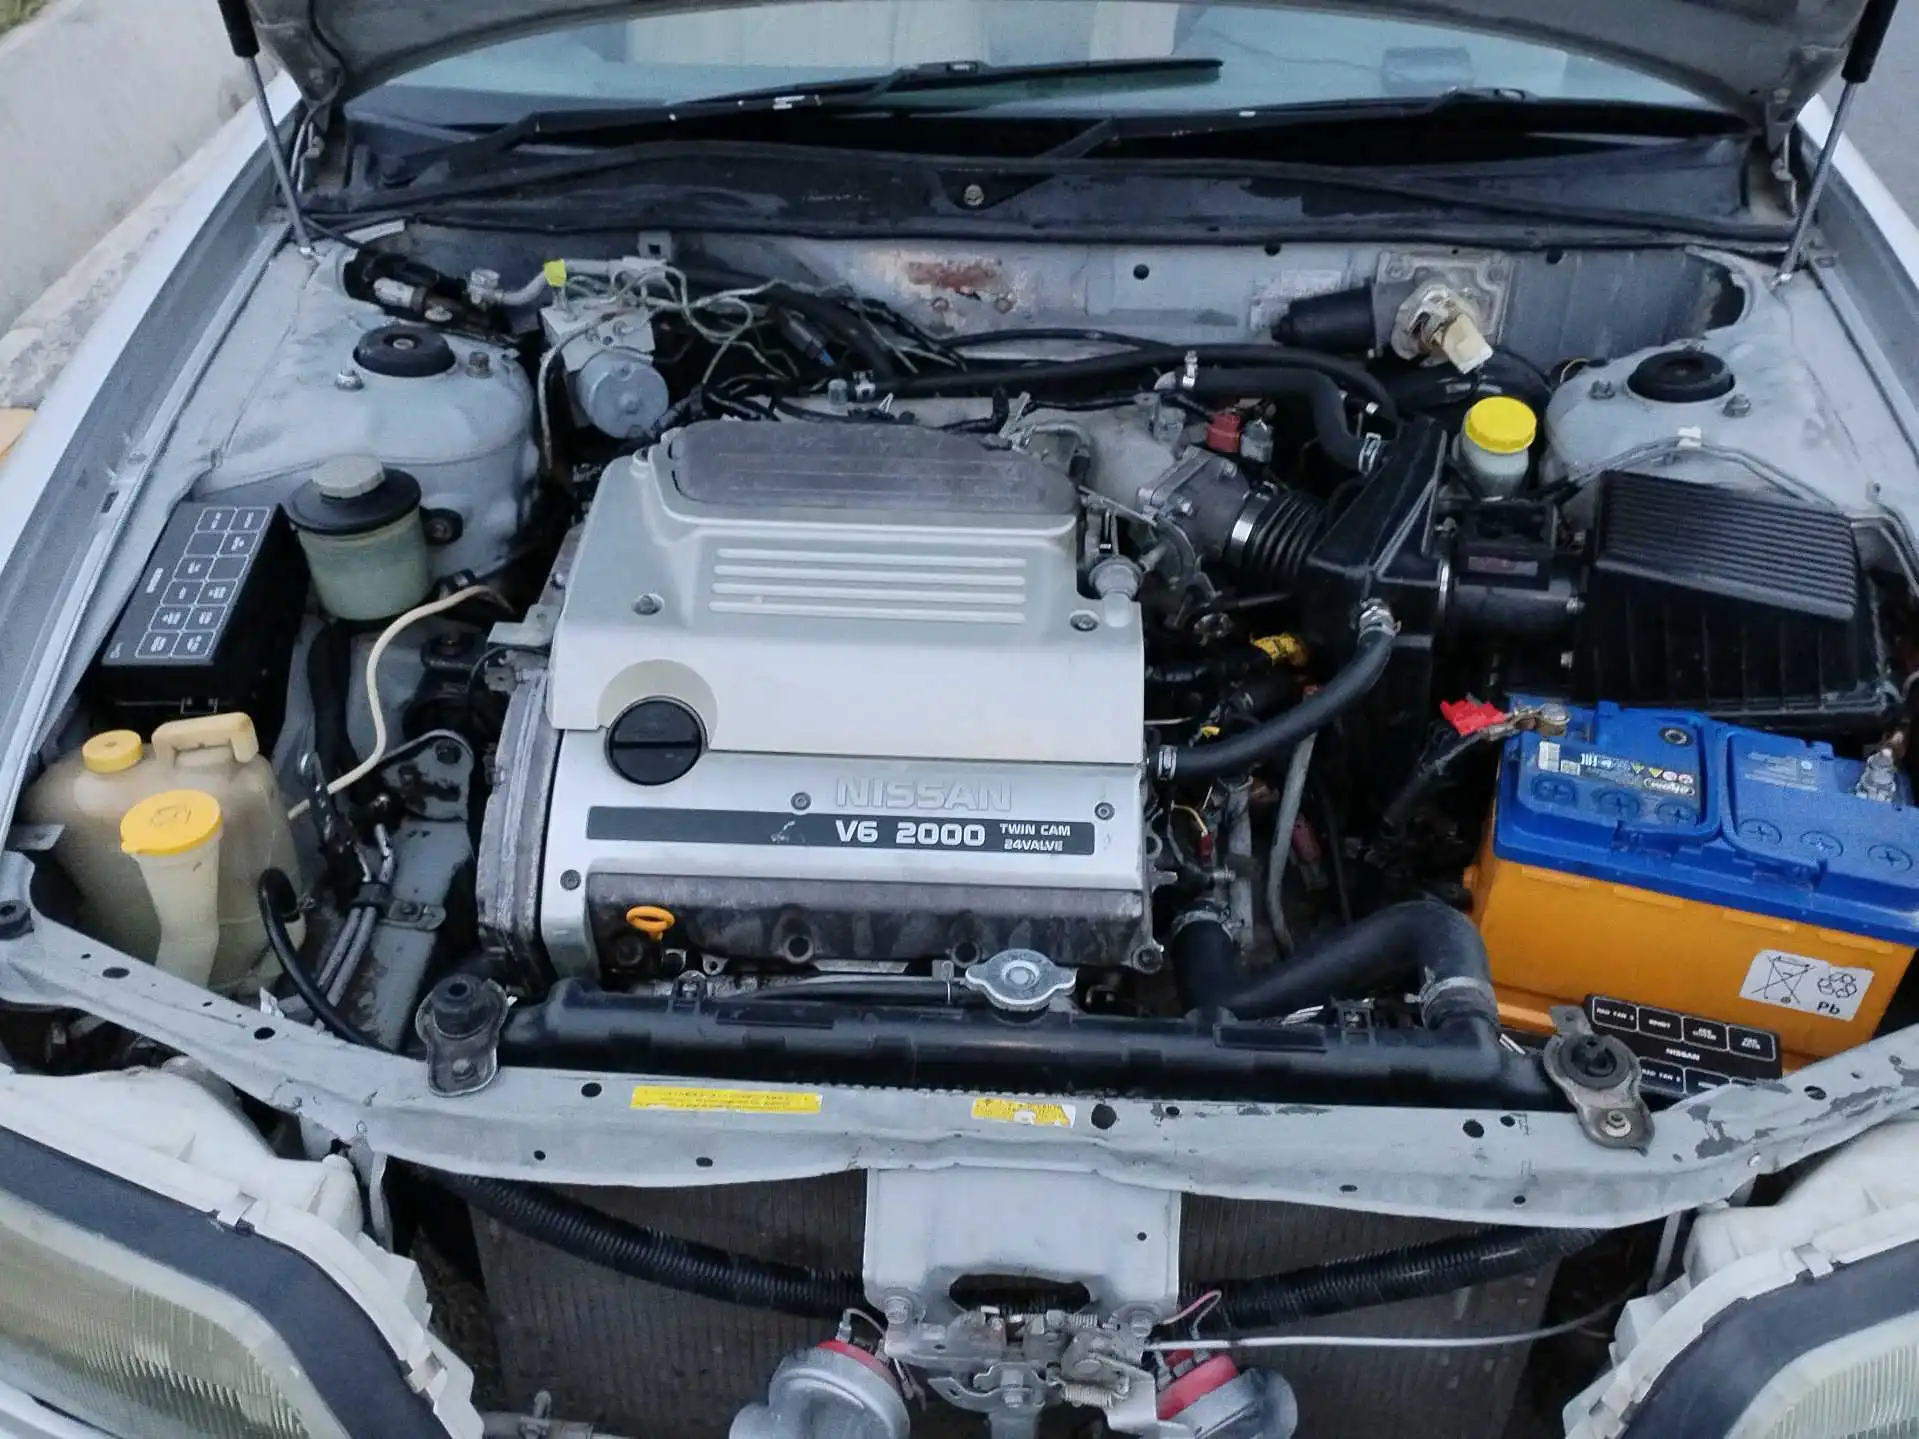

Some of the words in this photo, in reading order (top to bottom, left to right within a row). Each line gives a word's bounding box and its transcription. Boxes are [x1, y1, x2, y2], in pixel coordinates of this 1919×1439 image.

[837, 776, 1012, 812] NISSAN
[835, 819, 879, 843] V6
[895, 821, 985, 847] 2000
[1000, 823, 1036, 836] TWIN
[1040, 824, 1071, 837] CAM
[1817, 1001, 1840, 1015] Pb
[1665, 1047, 1700, 1062] NISSAN
